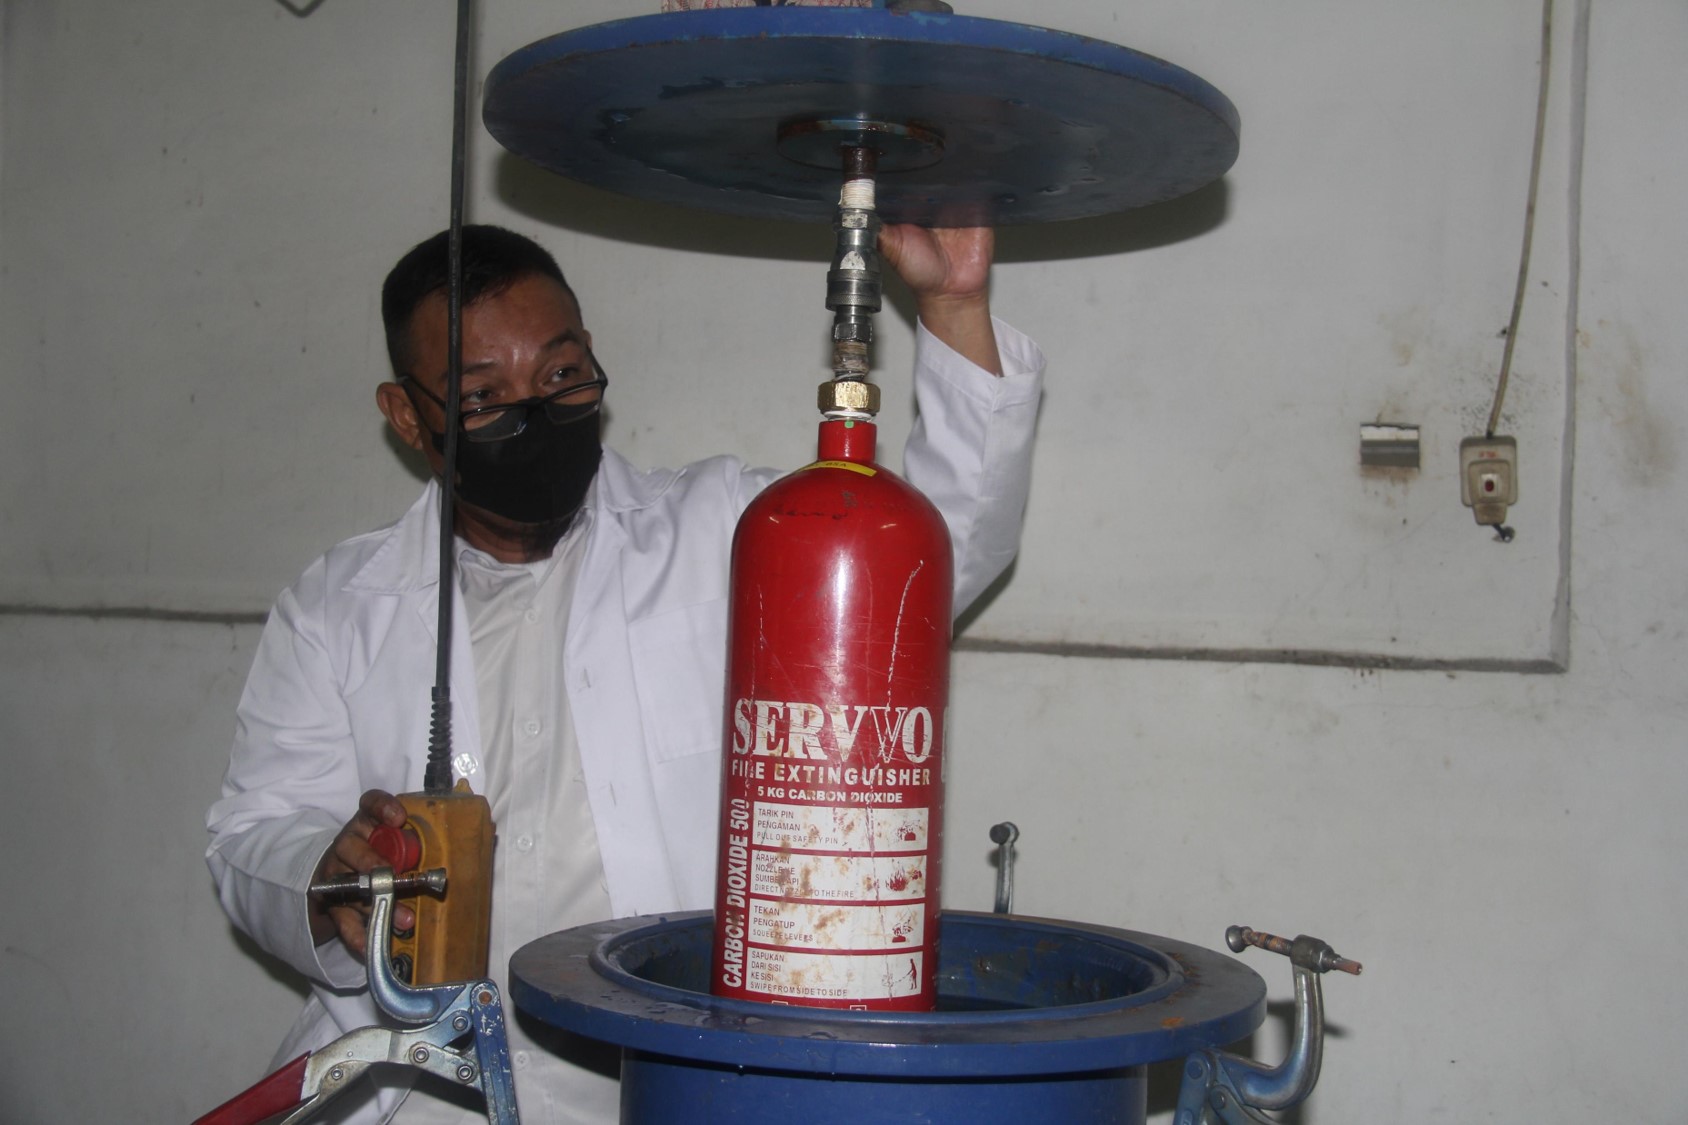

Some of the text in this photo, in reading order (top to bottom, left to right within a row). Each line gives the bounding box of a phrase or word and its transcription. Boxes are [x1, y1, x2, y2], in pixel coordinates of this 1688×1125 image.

[732, 698, 934, 764] SERVVO
[774, 763, 930, 786] EXTINGUISHER
[758, 786, 903, 803] 5 KG CARBON DIOXIDE
[758, 808, 794, 819] TARIK PIN
[757, 820, 800, 831] PENGAMAN
[757, 832, 773, 840] PULL
[793, 835, 823, 843] SAFETY
[756, 854, 790, 864] ARAHKAN
[726, 834, 748, 909] DIOXIDE
[784, 867, 795, 875] E
[755, 874, 784, 884] SUMBE
[754, 884, 778, 893] DIRECT
[821, 889, 834, 897] THE
[837, 890, 854, 898] FIRE
[754, 905, 780, 916] TEKAN
[753, 918, 795, 929] PENGATUP
[751, 951, 785, 962] SAPUKAN
[751, 961, 781, 972] DARI SISI
[751, 972, 774, 981] KE SISI
[750, 982, 847, 997] SWIPE FROM SIDE TO SIDE
